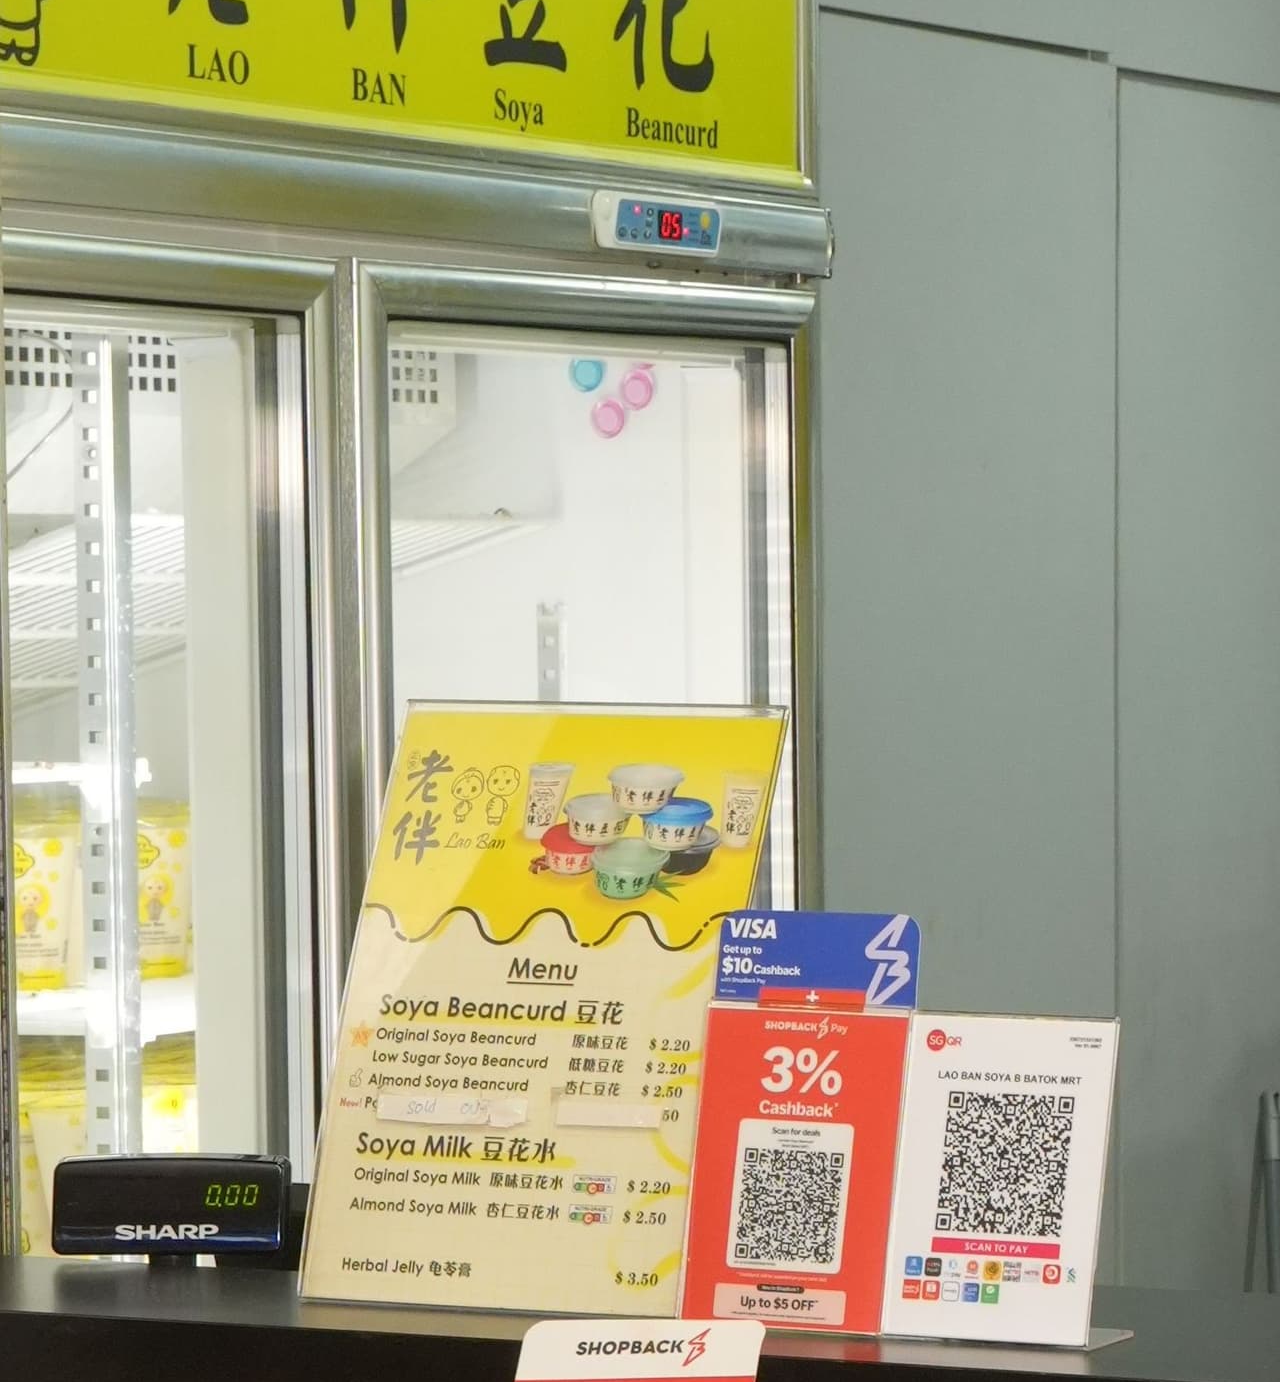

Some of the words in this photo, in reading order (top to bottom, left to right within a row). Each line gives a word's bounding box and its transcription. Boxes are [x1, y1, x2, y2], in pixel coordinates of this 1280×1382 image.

[187, 44, 250, 86] LAO
[351, 67, 408, 107] BAN
[493, 89, 544, 132] Soya
[626, 107, 719, 150] Beancurd
[391, 749, 454, 866] 老伴
[443, 831, 477, 850] Lao
[477, 832, 506, 851] Ban
[726, 918, 777, 940] VISA
[723, 945, 739, 954] Get
[740, 946, 752, 956] up
[753, 946, 762, 955] to
[508, 957, 578, 980] Menu
[722, 955, 753, 975] $10
[753, 964, 801, 976] Cashback
[379, 993, 439, 1017] Soya
[447, 996, 567, 1022] Beancurd
[574, 1000, 624, 1026] 豆花
[765, 1020, 818, 1033] SHOPBACK
[831, 1022, 848, 1034] Pay
[376, 1027, 429, 1044] Original
[432, 1029, 467, 1046] Soya
[470, 1031, 537, 1046] Beancurd
[661, 1039, 690, 1052] 2.20
[372, 1050, 398, 1064] Low
[402, 1051, 441, 1067] Sugar
[444, 1053, 478, 1069] Soya
[481, 1055, 549, 1070] Beancurd
[657, 1062, 687, 1075] 2.20
[760, 1045, 843, 1096] 3%
[368, 1073, 421, 1088] Almond
[425, 1075, 459, 1091] Soya
[463, 1077, 529, 1092] Beancurd
[653, 1085, 683, 1099] 2.50
[938, 1070, 958, 1080] LAO
[961, 1071, 982, 1081] BAN
[985, 1072, 1011, 1083] SOYA
[1023, 1074, 1058, 1084] BATOK
[1060, 1076, 1082, 1085] MRT
[772, 1126, 789, 1135] Scan
[791, 1127, 801, 1136] for
[802, 1128, 821, 1137] deals
[356, 1132, 416, 1160] Soya
[423, 1134, 473, 1159] Milk
[479, 1136, 557, 1163] 豆花水
[354, 1167, 409, 1185] Original
[412, 1169, 448, 1187] Soya
[451, 1171, 481, 1186] Milk
[640, 1180, 671, 1195] 2.20
[205, 1184, 259, 1207] 0.00
[349, 1196, 405, 1213] Almond
[408, 1198, 444, 1217] Soya
[448, 1201, 477, 1216] Milk
[636, 1210, 667, 1226] 2.50
[114, 1223, 219, 1241] SHARP
[964, 1241, 992, 1252] SCAN
[994, 1243, 1006, 1253] TO
[1009, 1244, 1029, 1255] PAY
[341, 1256, 388, 1274] Herbal
[391, 1258, 424, 1278] Jelly
[626, 1271, 659, 1288] 3.50
[740, 1295, 756, 1310] Up
[759, 1296, 771, 1308] to
[774, 1296, 788, 1310] $5
[576, 1339, 685, 1356] SHOPBACK
